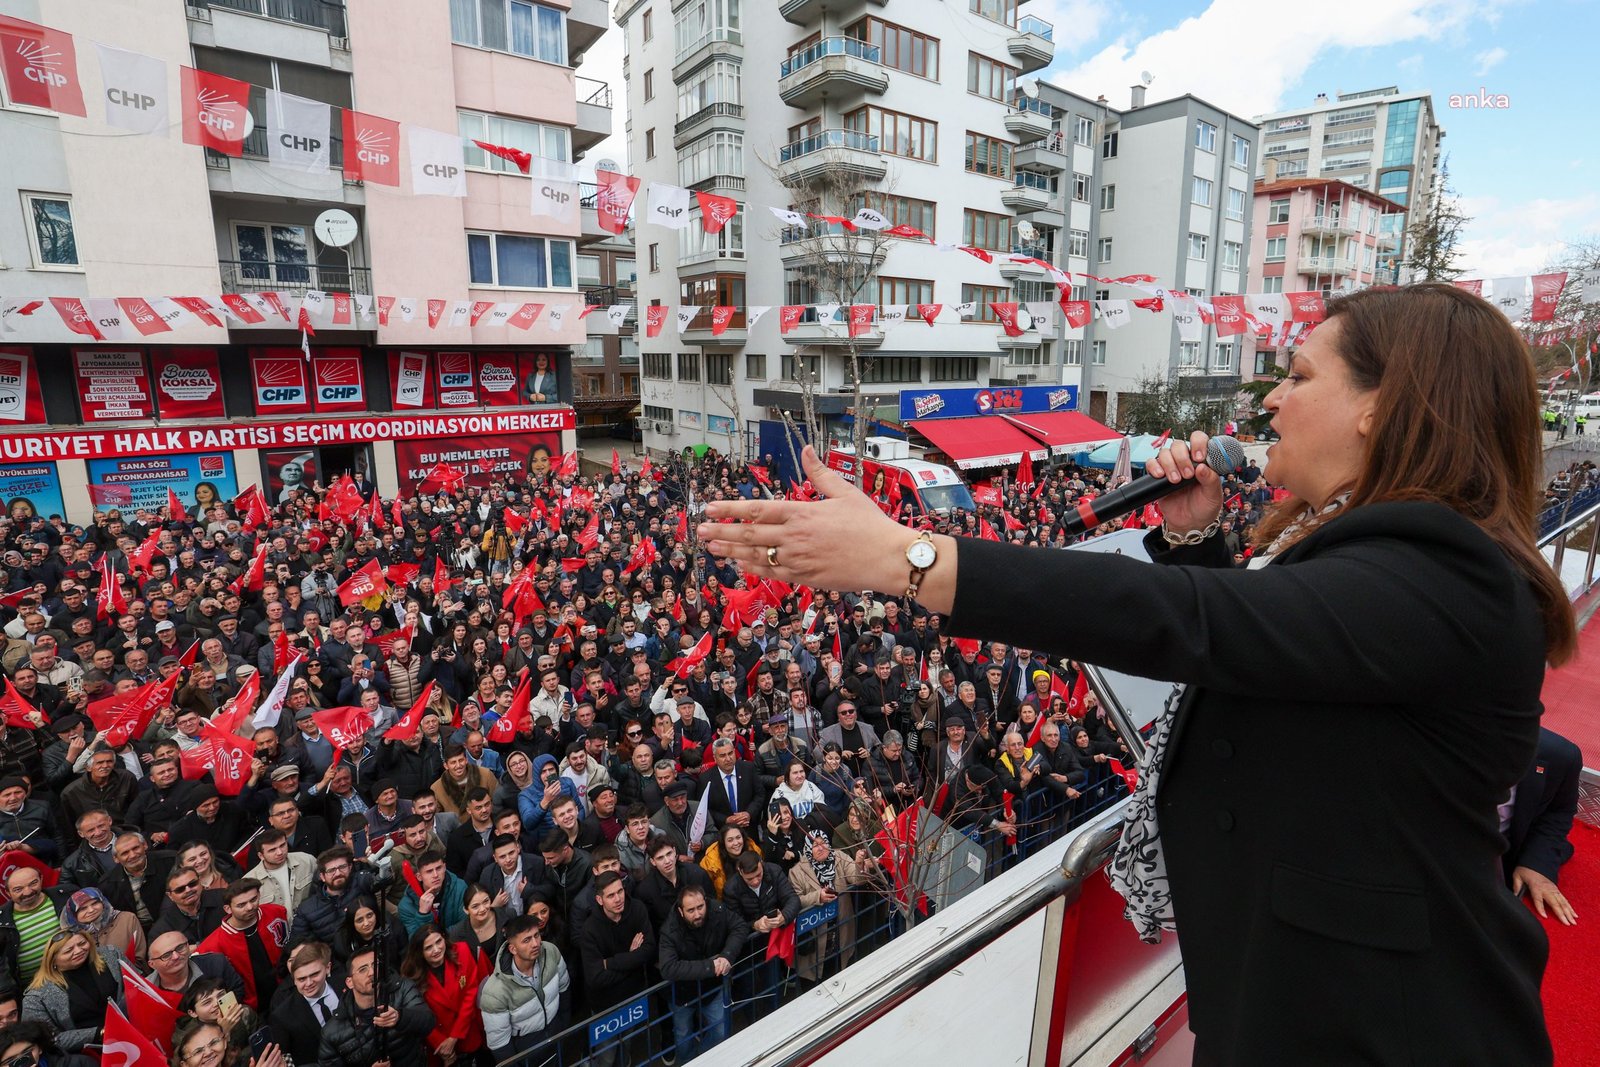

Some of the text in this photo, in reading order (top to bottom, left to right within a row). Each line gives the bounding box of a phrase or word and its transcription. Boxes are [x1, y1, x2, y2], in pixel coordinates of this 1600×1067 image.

[23, 66, 68, 88] CHP
[106, 88, 157, 111] CHP
[198, 111, 236, 132] CHP
[279, 134, 322, 153] CHP
[358, 149, 391, 166] CHP
[422, 163, 459, 179] CHP
[541, 186, 571, 204] CHP
[604, 204, 628, 216] CHP
[656, 205, 683, 218] CHP
[99, 318, 121, 328] CHP
[135, 314, 154, 325] CHP
[163, 366, 208, 379] Burcu
[404, 370, 421, 378] CHP
[481, 373, 515, 382] KÖKSAL
[162, 377, 215, 388] KÖKSAL
[443, 375, 469, 385] CHP
[262, 388, 301, 402] CHP
[322, 387, 358, 400] CHP
[402, 387, 419, 395] EVET
[108, 401, 127, 409] İMKAN
[114, 430, 184, 453] HALK
[188, 424, 276, 449] PARTİSİ
[282, 418, 346, 444] SEÇİM
[350, 410, 492, 438] KOORDİNASYON
[497, 405, 564, 430] MERKEZİ
[420, 448, 509, 466] BU MEMLEKETE
[120, 459, 169, 470] SANA SÖZ!
[105, 470, 187, 482] AFYONKARAHİSAR
[203, 470, 223, 478] CHP
[9, 481, 49, 492] GÜZEL
[130, 485, 168, 495] AFJET İÇİN
[7, 489, 43, 498] OLACAK
[105, 496, 123, 504] CHP
[594, 1005, 644, 1041] POLİS
